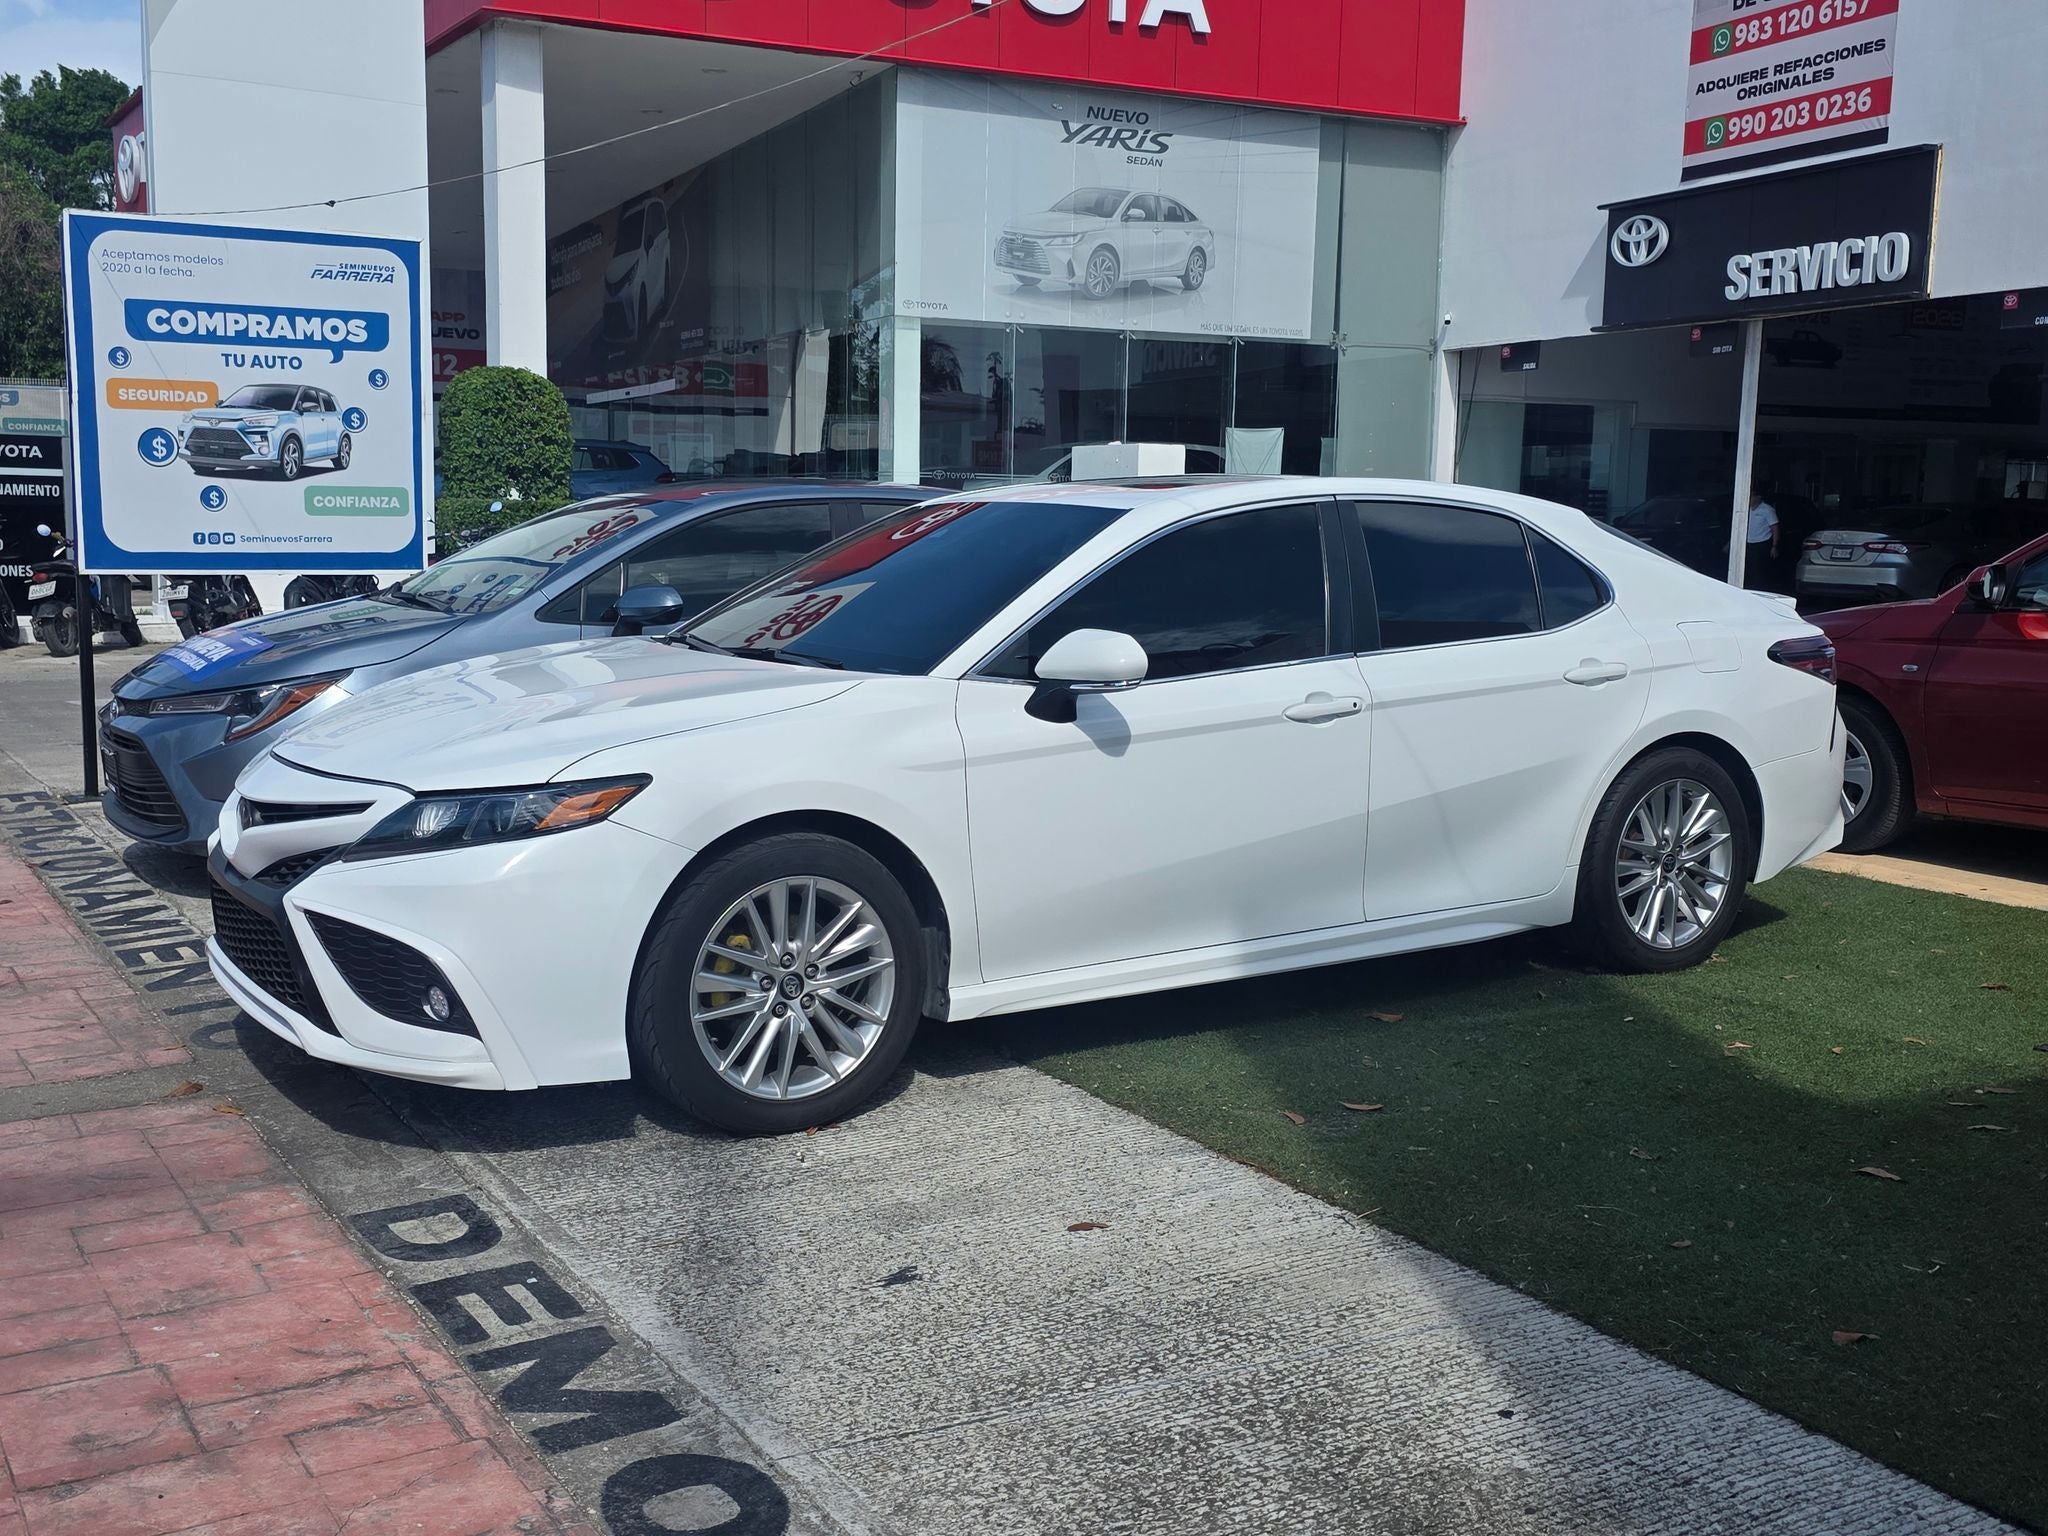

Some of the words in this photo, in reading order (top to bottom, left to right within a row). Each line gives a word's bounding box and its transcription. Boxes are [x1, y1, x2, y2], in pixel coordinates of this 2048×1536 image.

[1734, 15, 1773, 48] 983
[1778, 4, 1815, 36] 120
[1819, 0, 1871, 25] 6157
[1695, 66, 1769, 96] ADQUIERE
[1773, 38, 1887, 77] REFACCIONES
[1736, 66, 1836, 101] ORIGINALES
[1086, 105, 1150, 125] NUEVO
[1728, 110, 1767, 141] 990
[1769, 101, 1810, 132] 203
[1815, 87, 1873, 122] 0236
[1126, 155, 1164, 168] SEDÁN
[101, 248, 170, 263] Aceptamos
[173, 253, 224, 266] modelos
[102, 262, 131, 273] 2020
[134, 266, 142, 275] a
[145, 264, 156, 275] la
[159, 265, 196, 278] fecha.
[338, 262, 396, 273] SEMINUEVOS
[1724, 231, 1911, 301] SERVICIO
[311, 269, 395, 284] FARRERA
[915, 301, 949, 311] TOYOTA
[146, 307, 369, 343] COMPRAMOS
[221, 352, 246, 369] TU
[250, 354, 303, 371] AUTO
[118, 387, 209, 404] SEGURIDAD
[8, 423, 64, 432] CONFIANZA
[313, 495, 400, 510] CONFIANZA
[239, 534, 333, 544] SeminuevosFarrera
